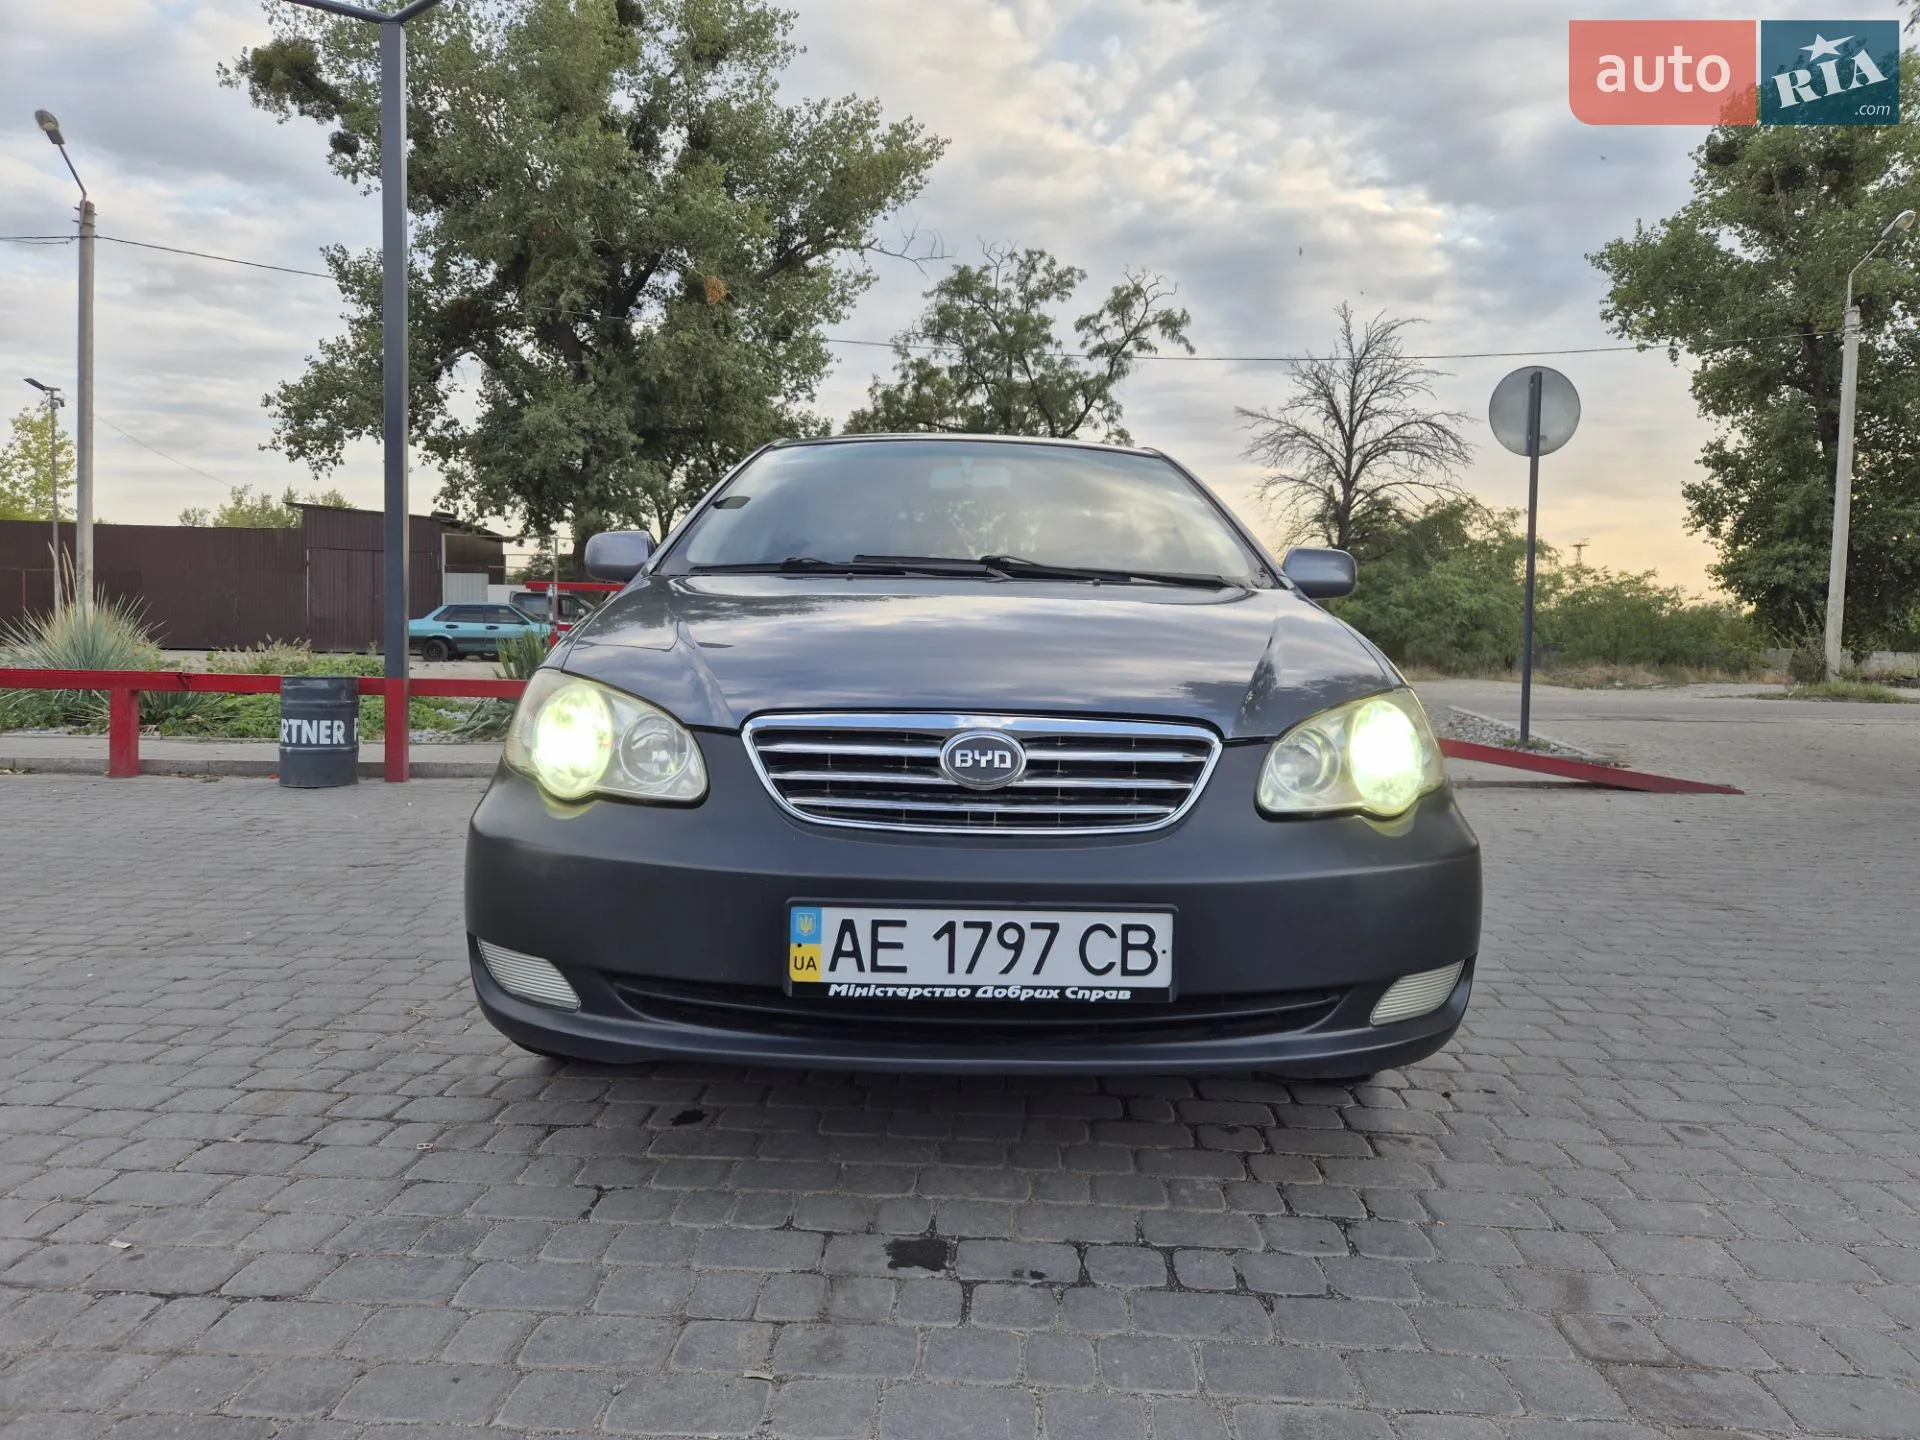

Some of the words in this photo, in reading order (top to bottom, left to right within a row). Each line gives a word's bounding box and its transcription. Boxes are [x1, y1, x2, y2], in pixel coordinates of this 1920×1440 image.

[955, 749, 1012, 769] BYD
[828, 918, 908, 973] AE
[932, 920, 1060, 975] 1797
[1078, 922, 1159, 977] CB
[793, 956, 817, 971] UA
[828, 983, 972, 1000] Міністерство
[975, 985, 1061, 1001] Добрих
[1064, 986, 1132, 1002] Справ
